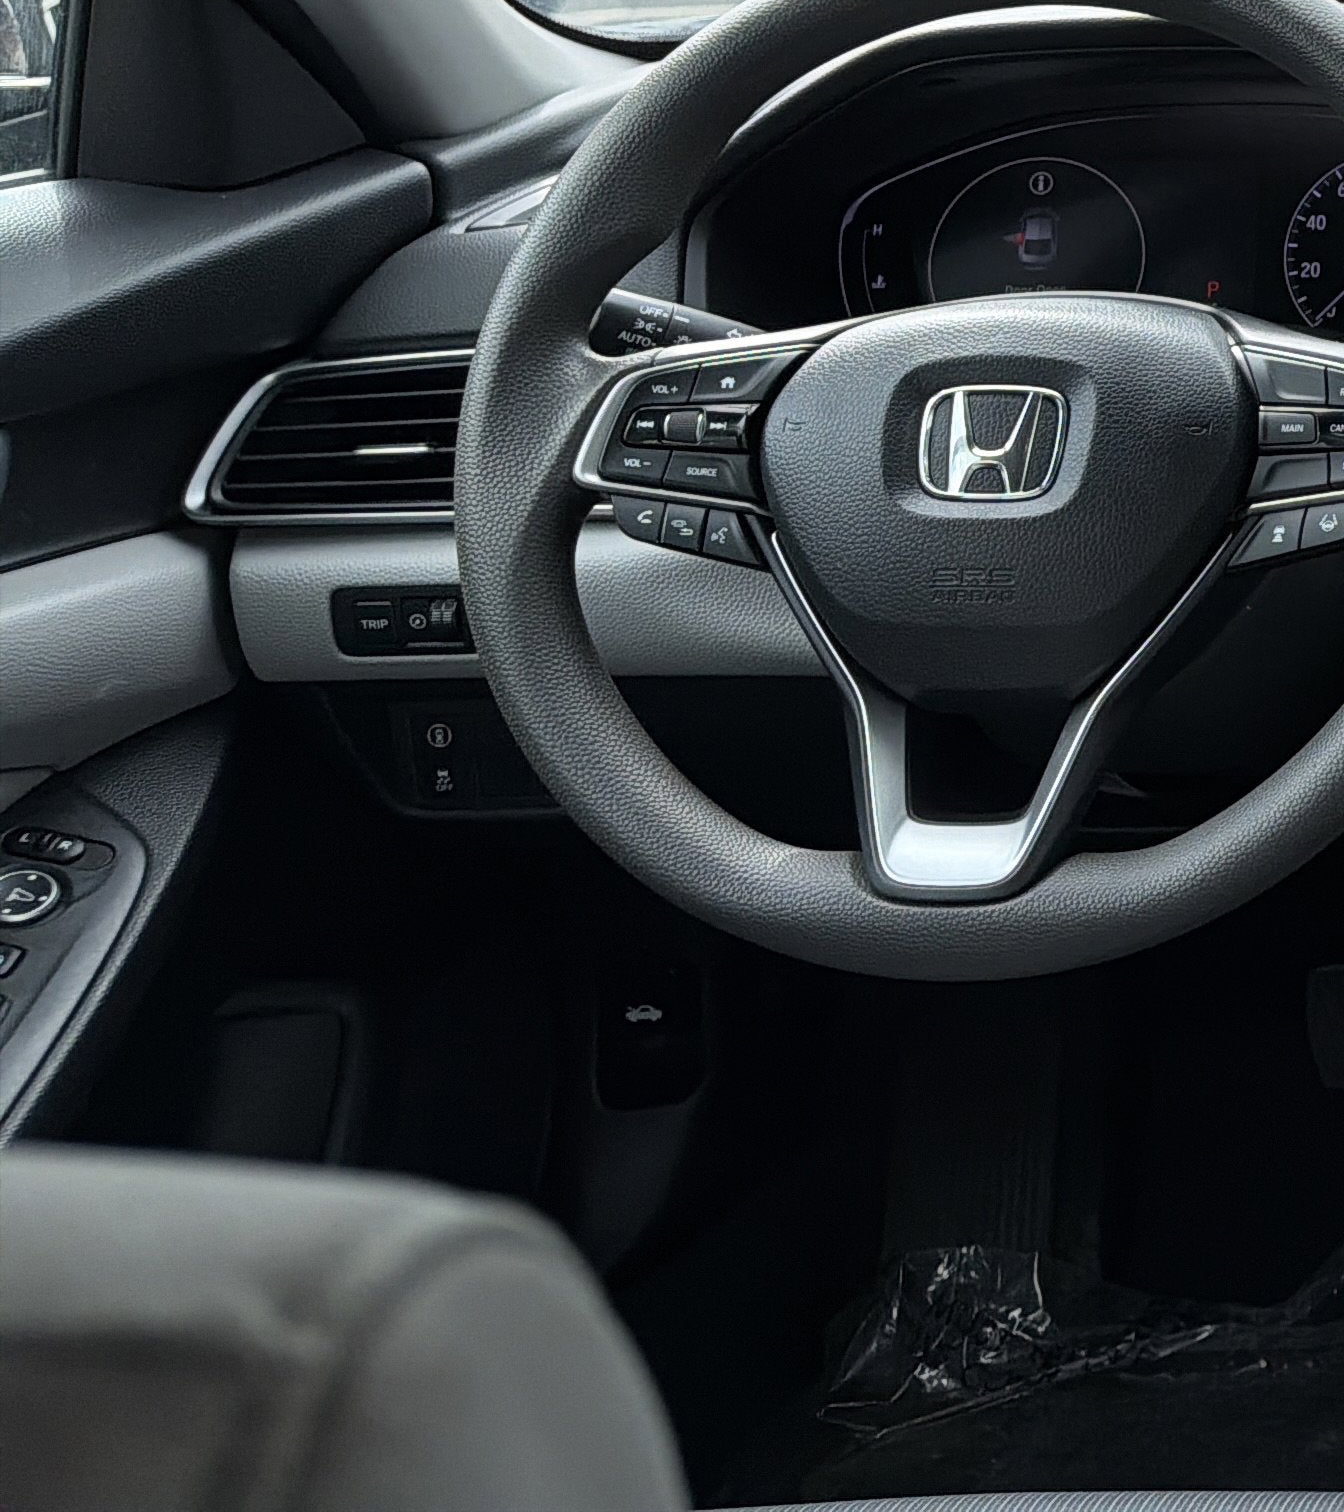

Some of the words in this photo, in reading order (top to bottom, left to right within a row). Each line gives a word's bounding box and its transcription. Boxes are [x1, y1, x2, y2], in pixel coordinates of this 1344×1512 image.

[1306, 214, 1327, 231] 40
[872, 225, 883, 237] H
[1300, 262, 1321, 278] 20
[1207, 281, 1220, 298] P
[639, 304, 664, 318] OFF
[617, 330, 652, 348] AUTO
[651, 384, 669, 394] VOL
[1280, 423, 1304, 433] MAIN
[623, 458, 642, 468] VOL
[686, 466, 719, 477] SOURCE
[931, 568, 1016, 587] SRS
[360, 619, 389, 630] TRIP
[19, 832, 30, 843] L
[58, 839, 73, 851] R
